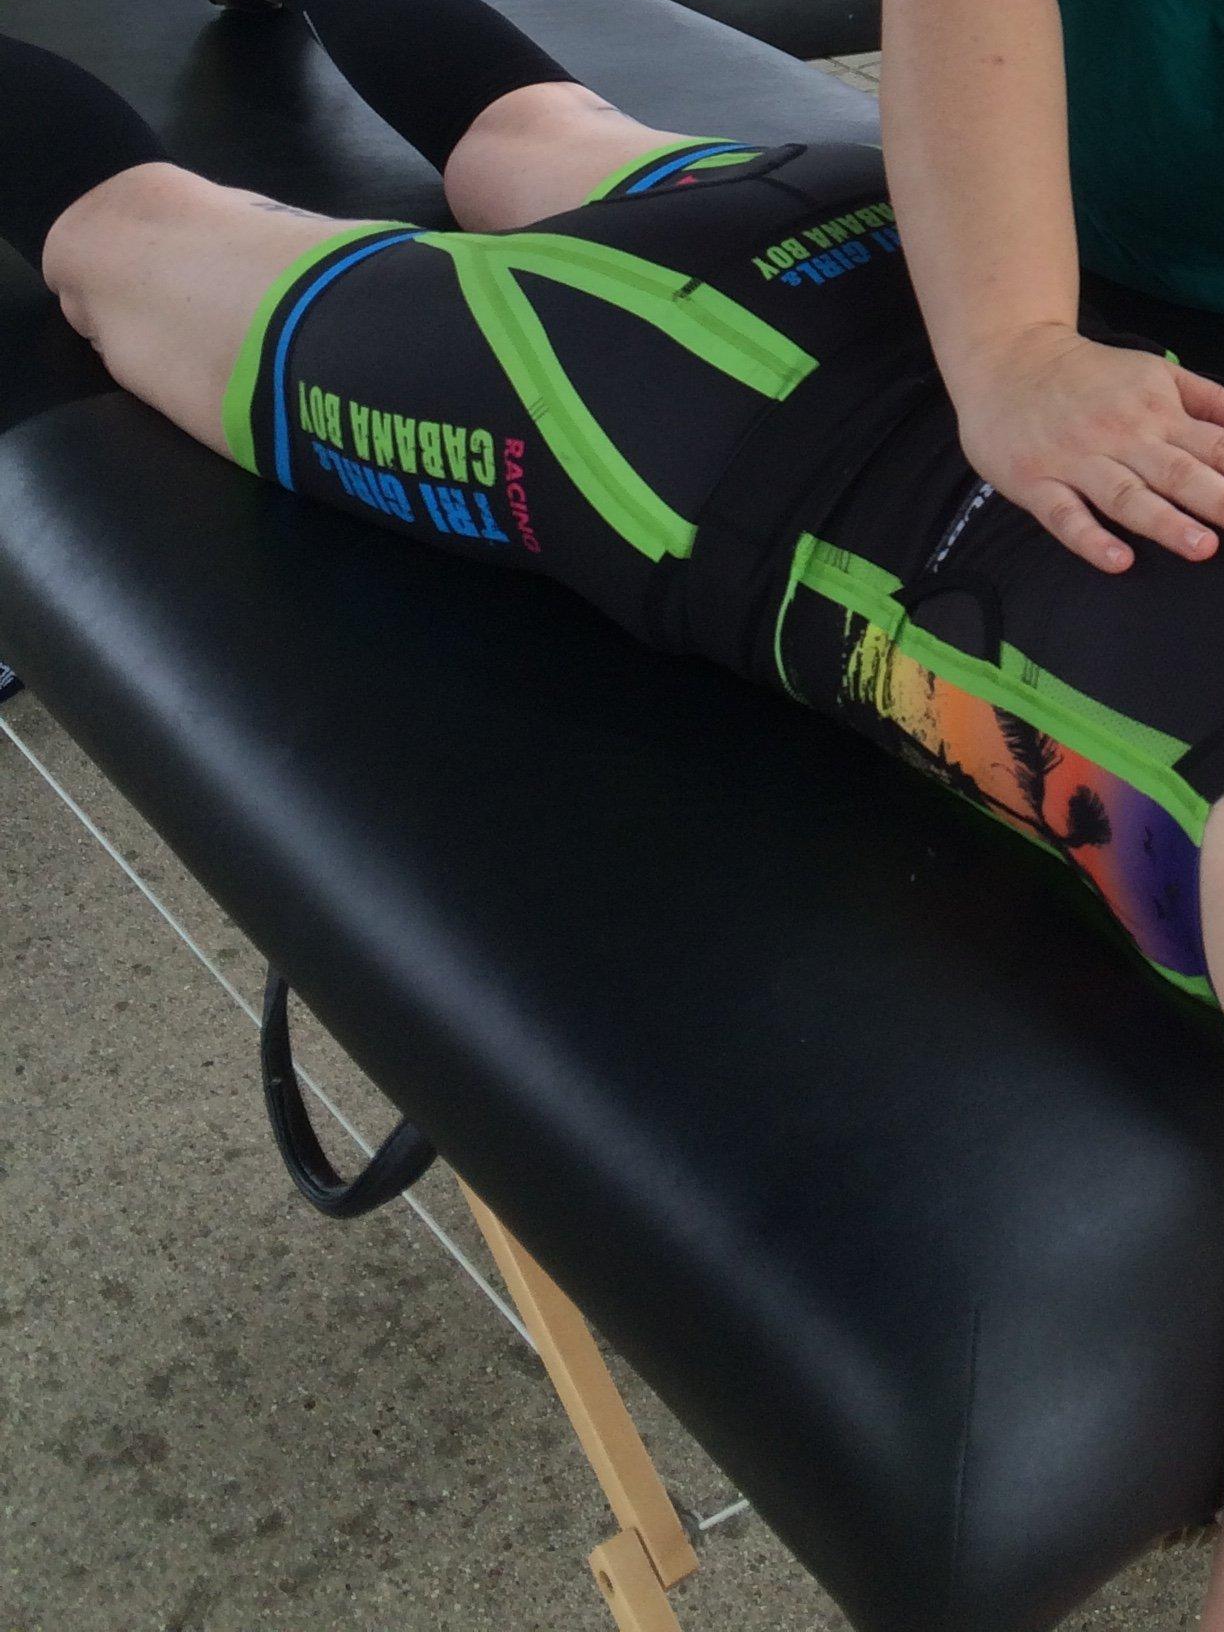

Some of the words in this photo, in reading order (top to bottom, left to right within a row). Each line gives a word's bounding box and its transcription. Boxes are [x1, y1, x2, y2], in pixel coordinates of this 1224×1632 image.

[802, 202, 896, 249] ABANA
[751, 237, 811, 281] BOY
[795, 240, 872, 286] GIRL
[299, 380, 344, 450] BOY
[350, 400, 496, 488] CABANA
[328, 449, 415, 523] GIRL
[420, 482, 510, 544] TRI
[505, 437, 542, 553] RACING
